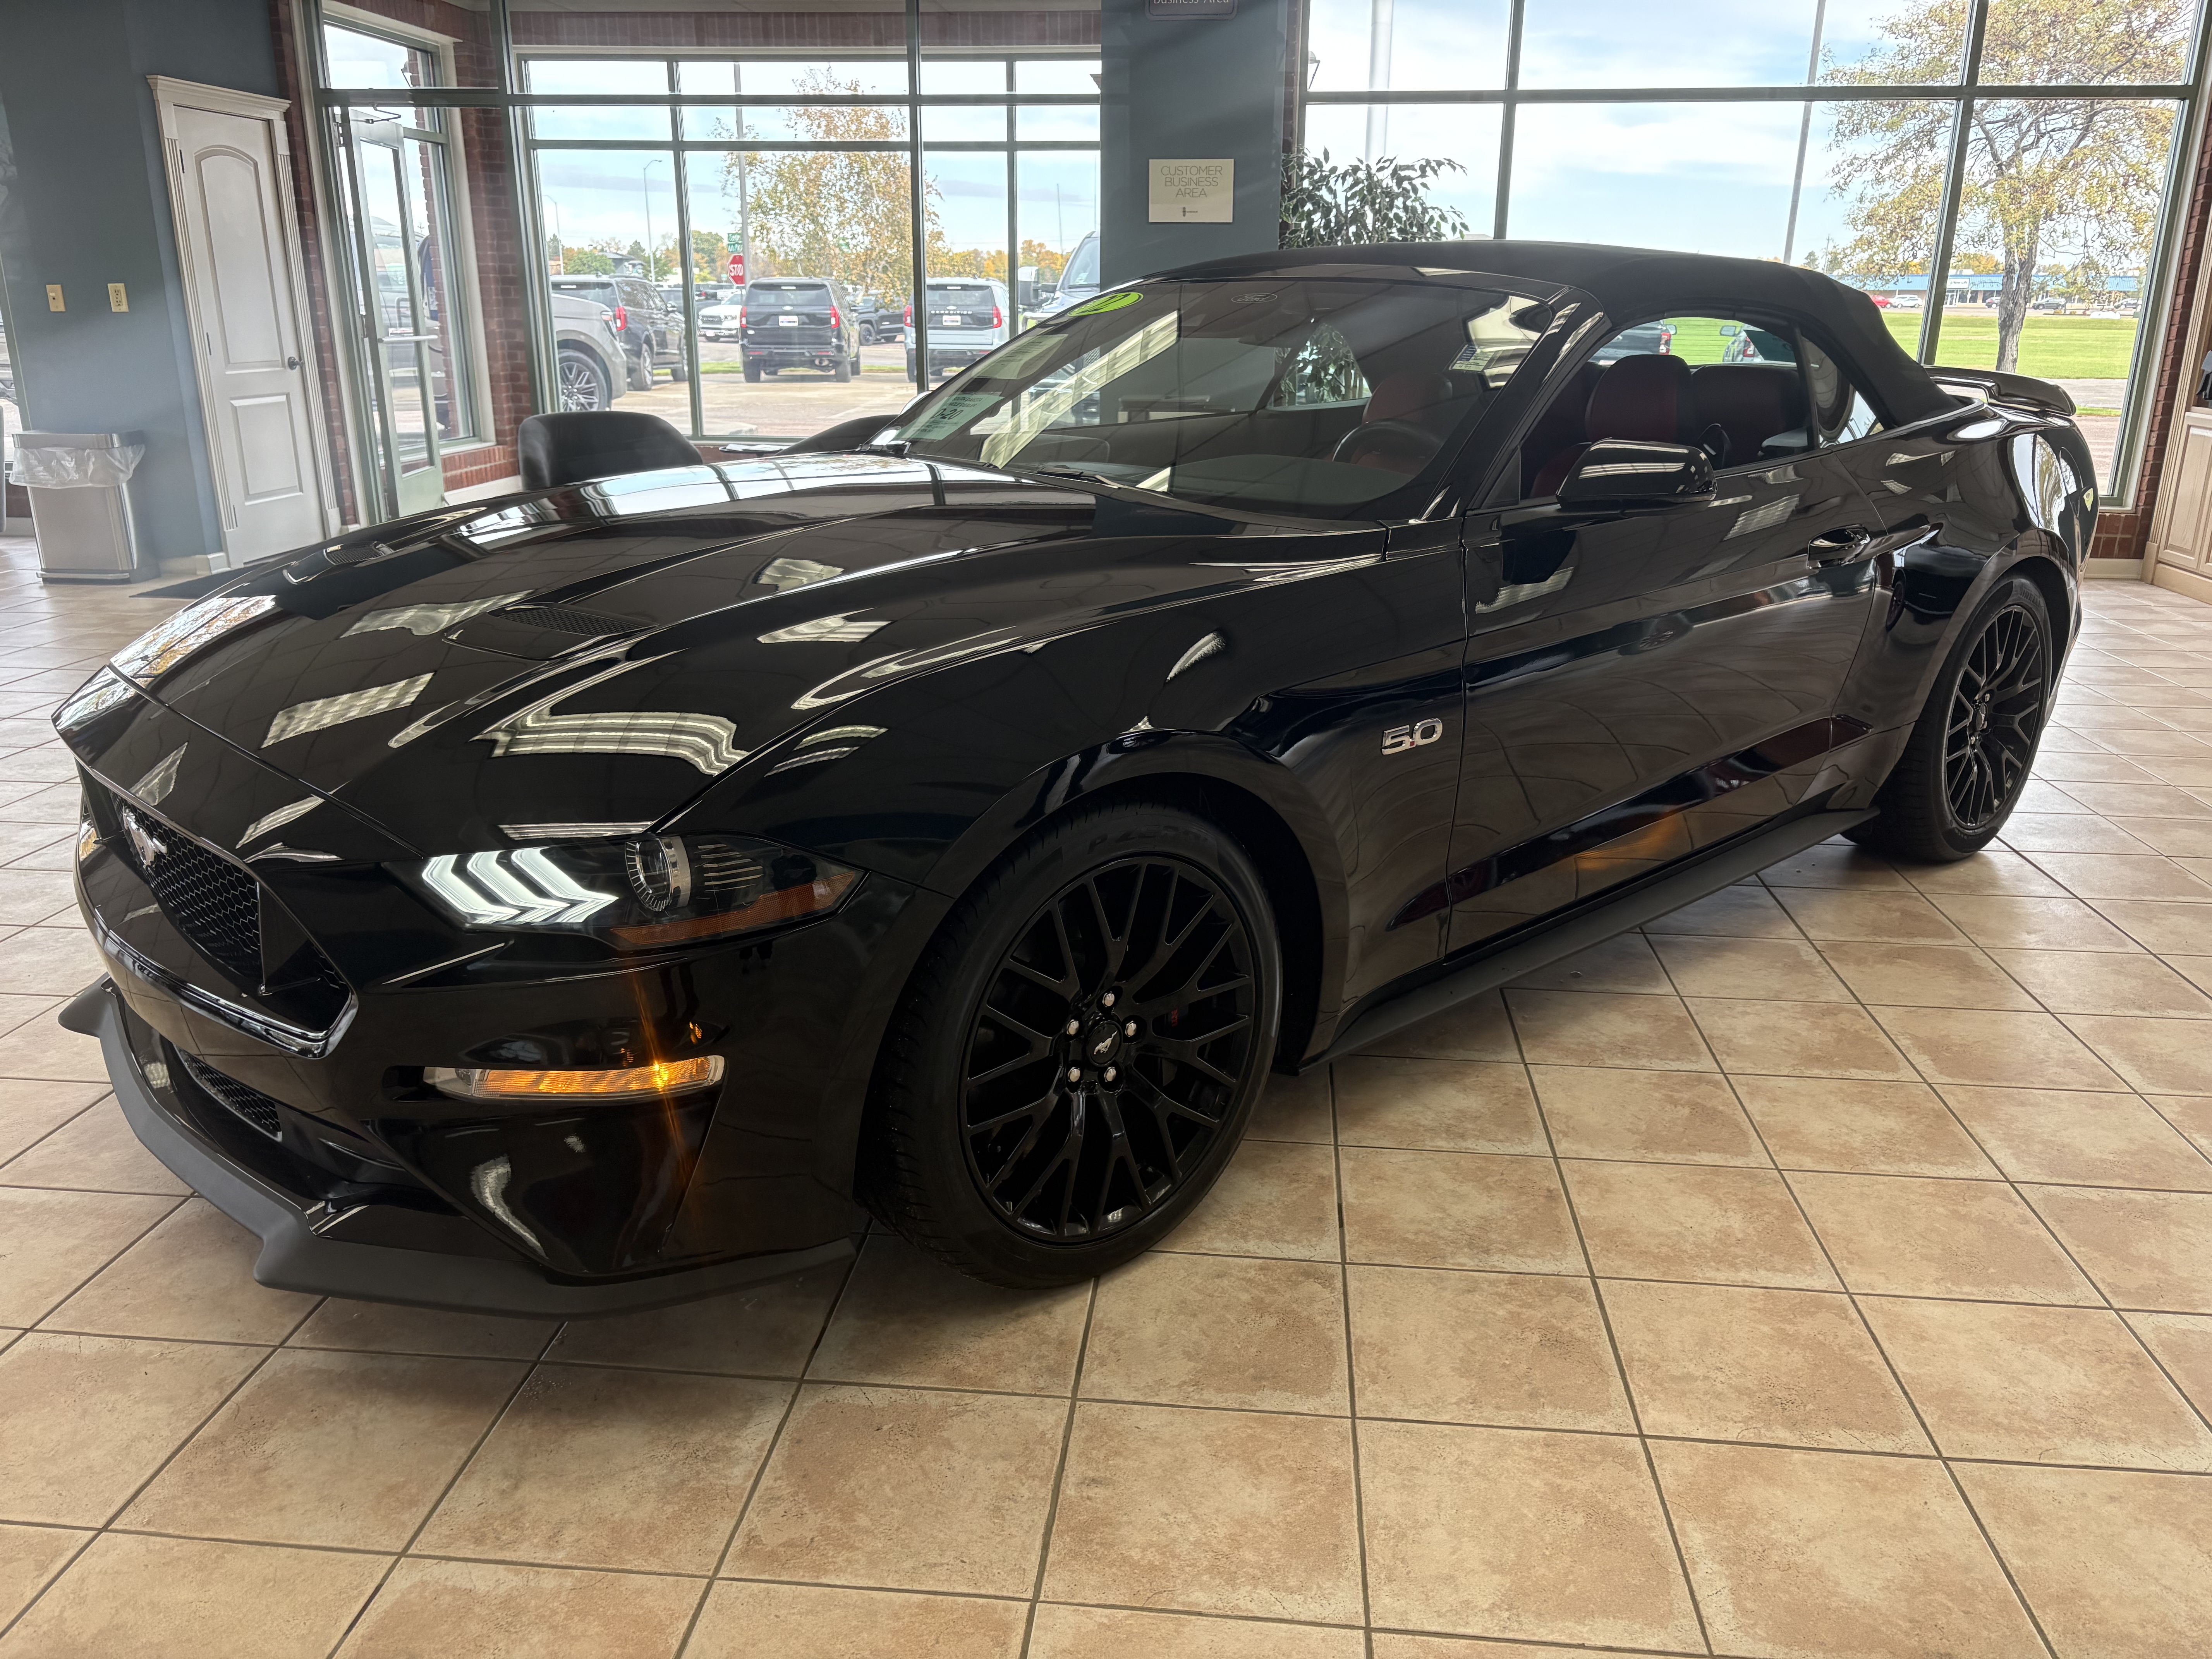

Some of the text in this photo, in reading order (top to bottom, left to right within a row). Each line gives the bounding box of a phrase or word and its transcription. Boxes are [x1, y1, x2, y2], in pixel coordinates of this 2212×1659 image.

[1161, 166, 1223, 175] CUSTOMER
[1165, 177, 1218, 187] BUSINESS
[1175, 187, 1207, 198] AREA
[729, 264, 744, 276] STO
[1381, 717, 1443, 755] 5.0
